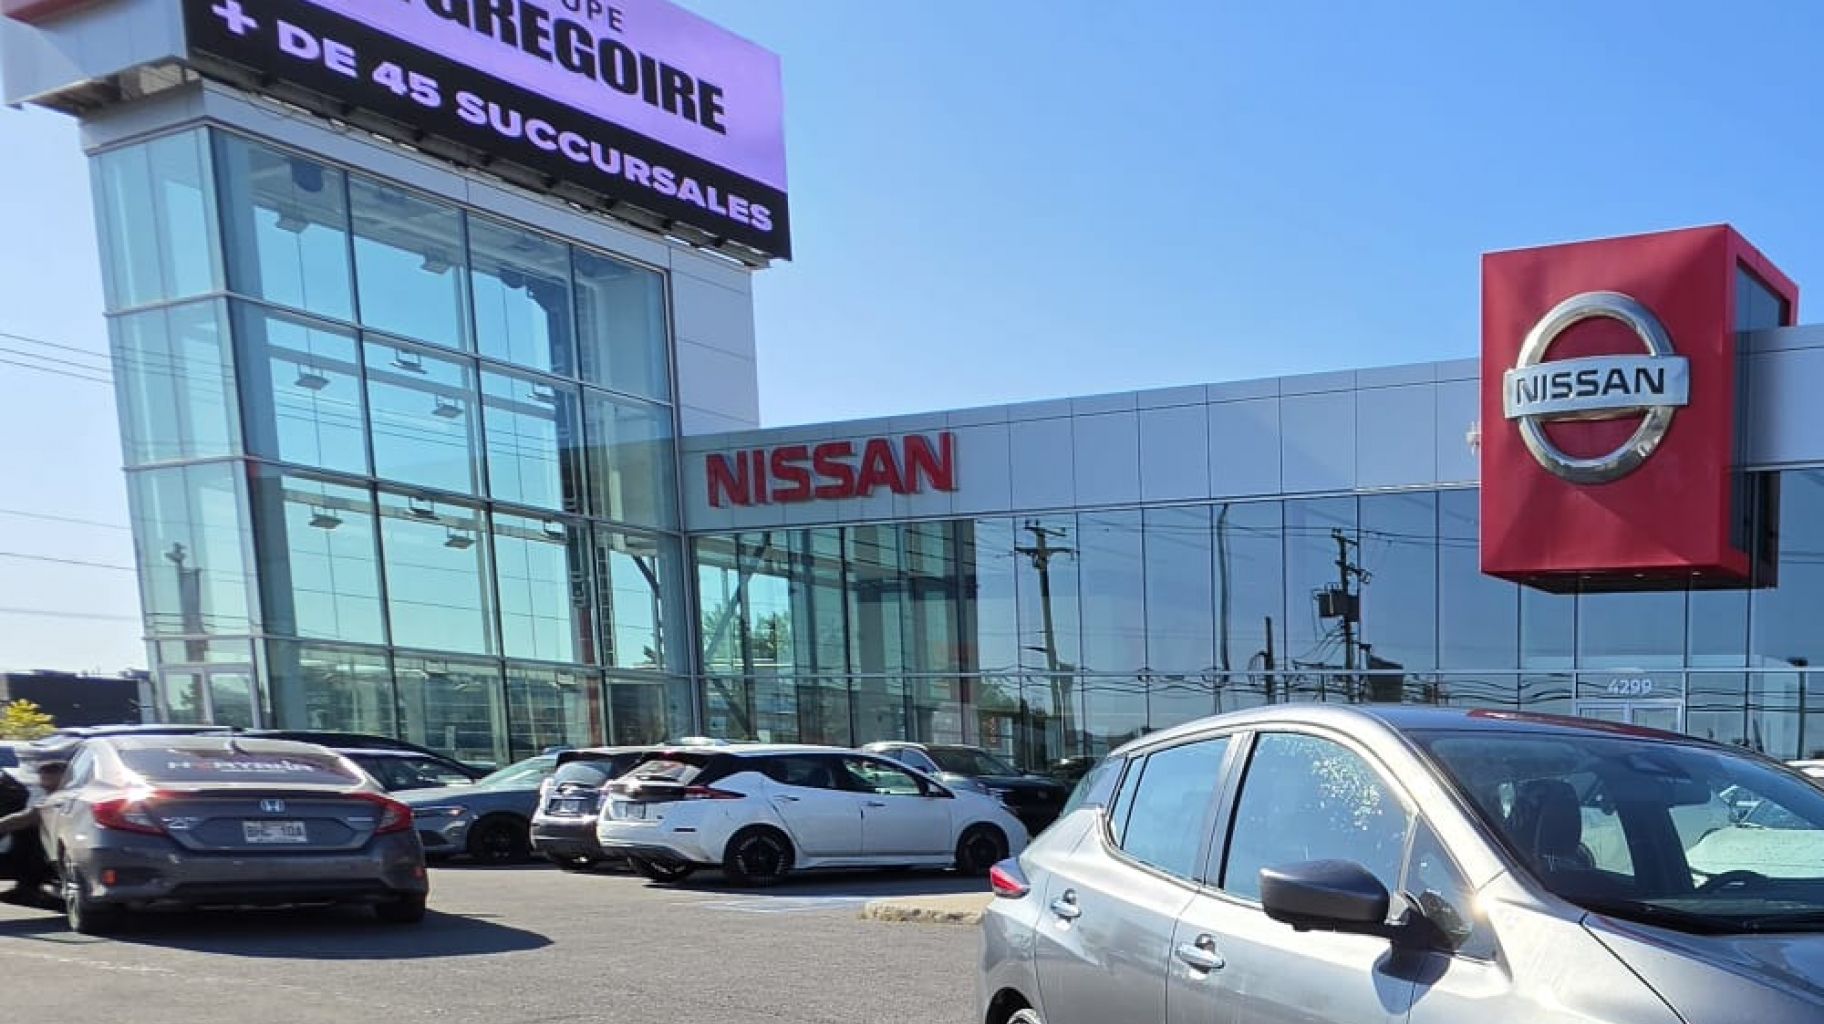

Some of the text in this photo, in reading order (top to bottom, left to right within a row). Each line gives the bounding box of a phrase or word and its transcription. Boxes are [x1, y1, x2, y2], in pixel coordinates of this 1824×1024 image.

[276, 20, 358, 78] DE
[371, 61, 442, 107] 45
[455, 91, 773, 231] SUCCURSALES
[1517, 367, 1665, 405] NISSAN
[705, 431, 957, 508] NISSAN
[1606, 678, 1652, 694] 4299
